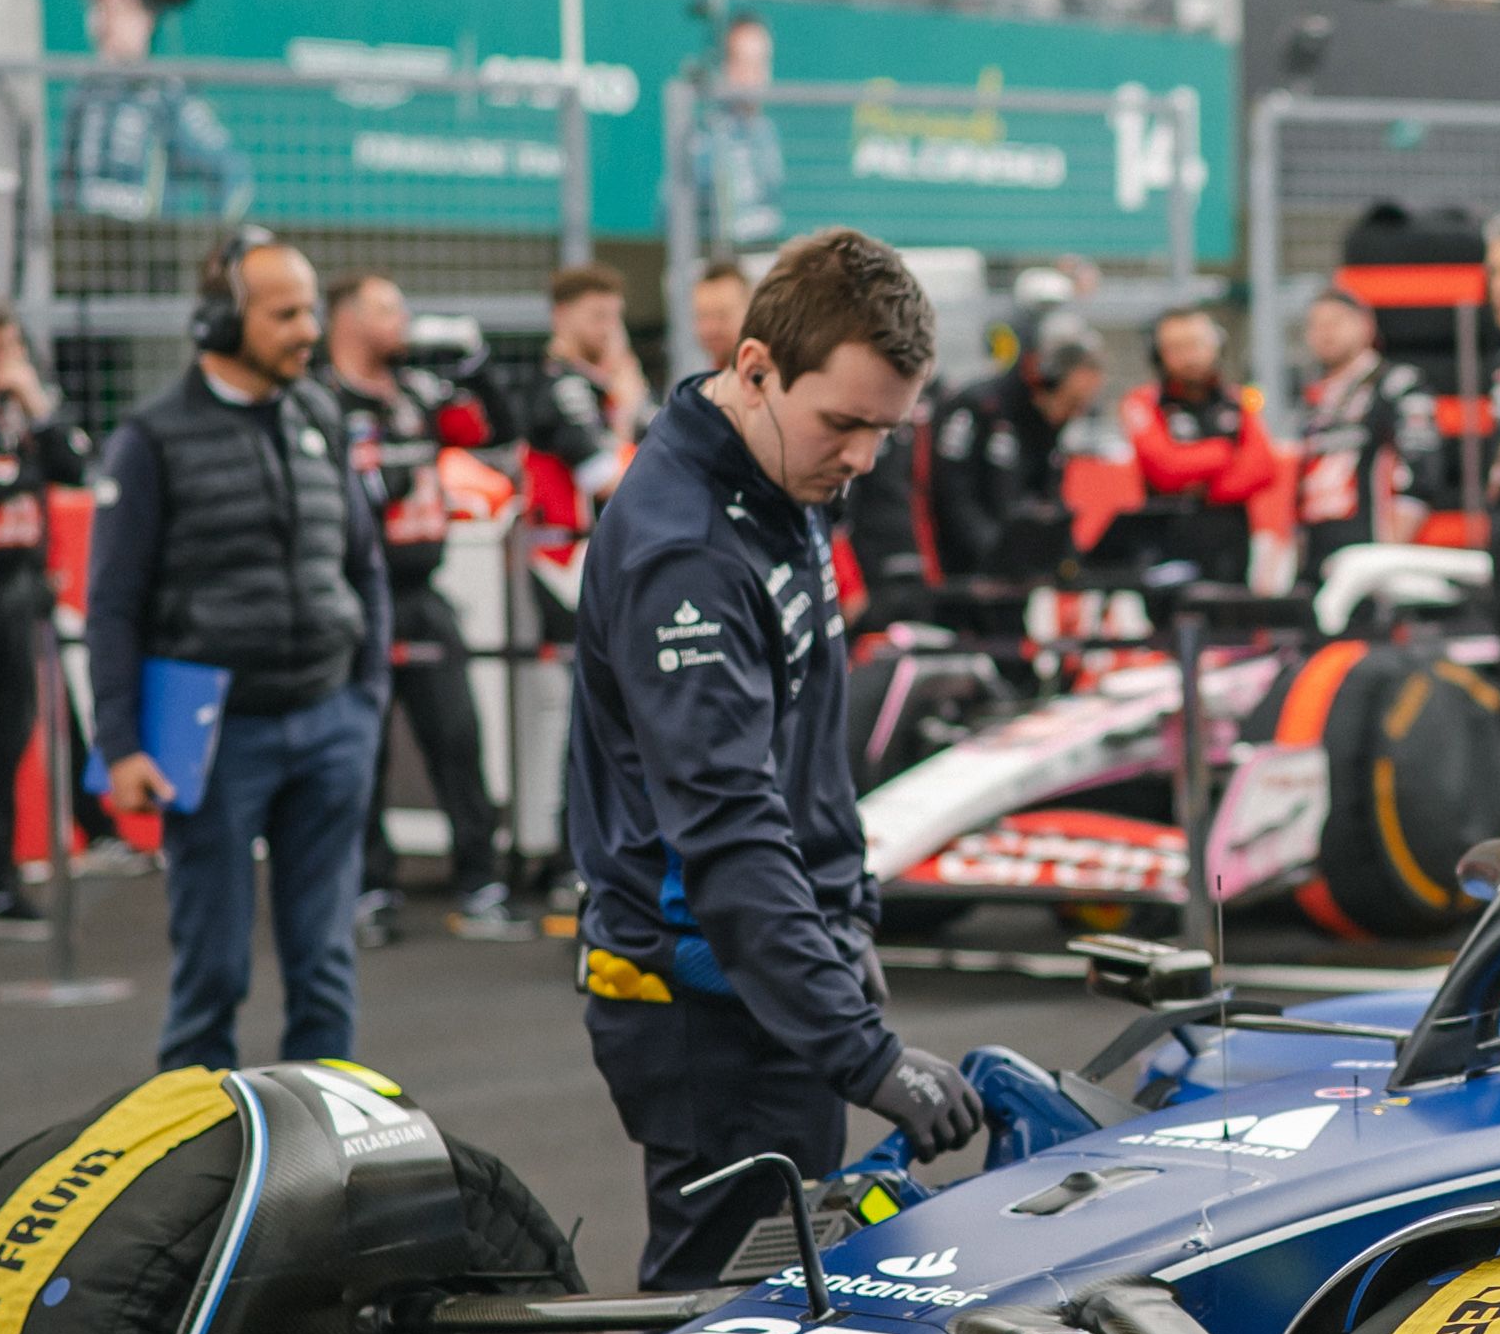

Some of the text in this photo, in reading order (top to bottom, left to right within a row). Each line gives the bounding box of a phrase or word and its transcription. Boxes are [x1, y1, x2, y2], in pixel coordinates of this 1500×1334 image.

[343, 1124, 426, 1158] ATLASSIAN
[1118, 1132, 1299, 1161] ATLASSIAN
[766, 1267, 988, 1310] Santander
